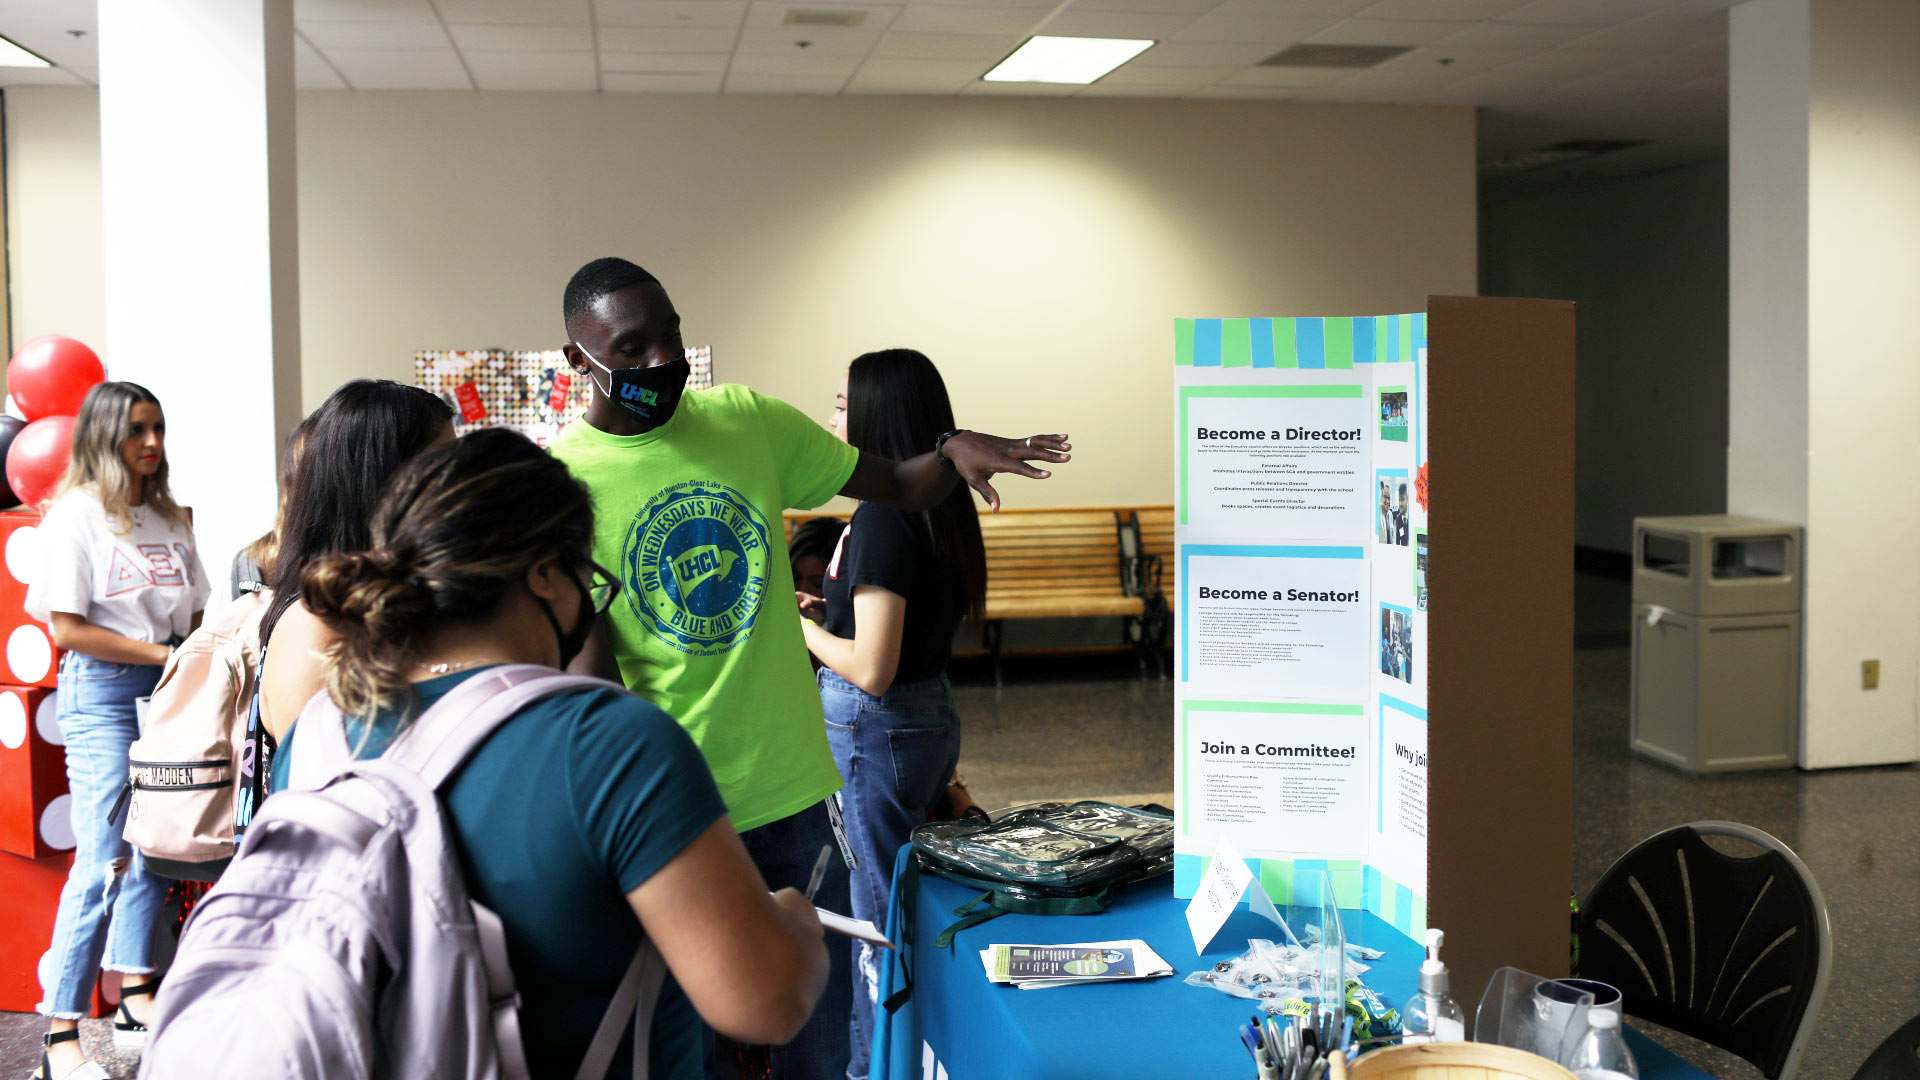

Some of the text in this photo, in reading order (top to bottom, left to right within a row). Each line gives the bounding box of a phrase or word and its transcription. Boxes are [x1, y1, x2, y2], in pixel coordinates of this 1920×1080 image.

[620, 382, 658, 406] UHCL
[1197, 427, 1362, 441] Become a Director!
[634, 494, 658, 520] University
[664, 480, 706, 494] Houston-Clear
[706, 480, 721, 489] Lake
[642, 500, 759, 592] ON WEDNESDAYS WE WEAR
[678, 548, 720, 582] UHCL
[670, 576, 764, 636] BLUE AND GREEN
[1199, 586, 1359, 602] Become a Senator!
[676, 644, 693, 655] Office
[1200, 741, 1356, 758] Join a Committee!
[1395, 742, 1428, 768] Why joi
[152, 768, 194, 785] MADDEN
